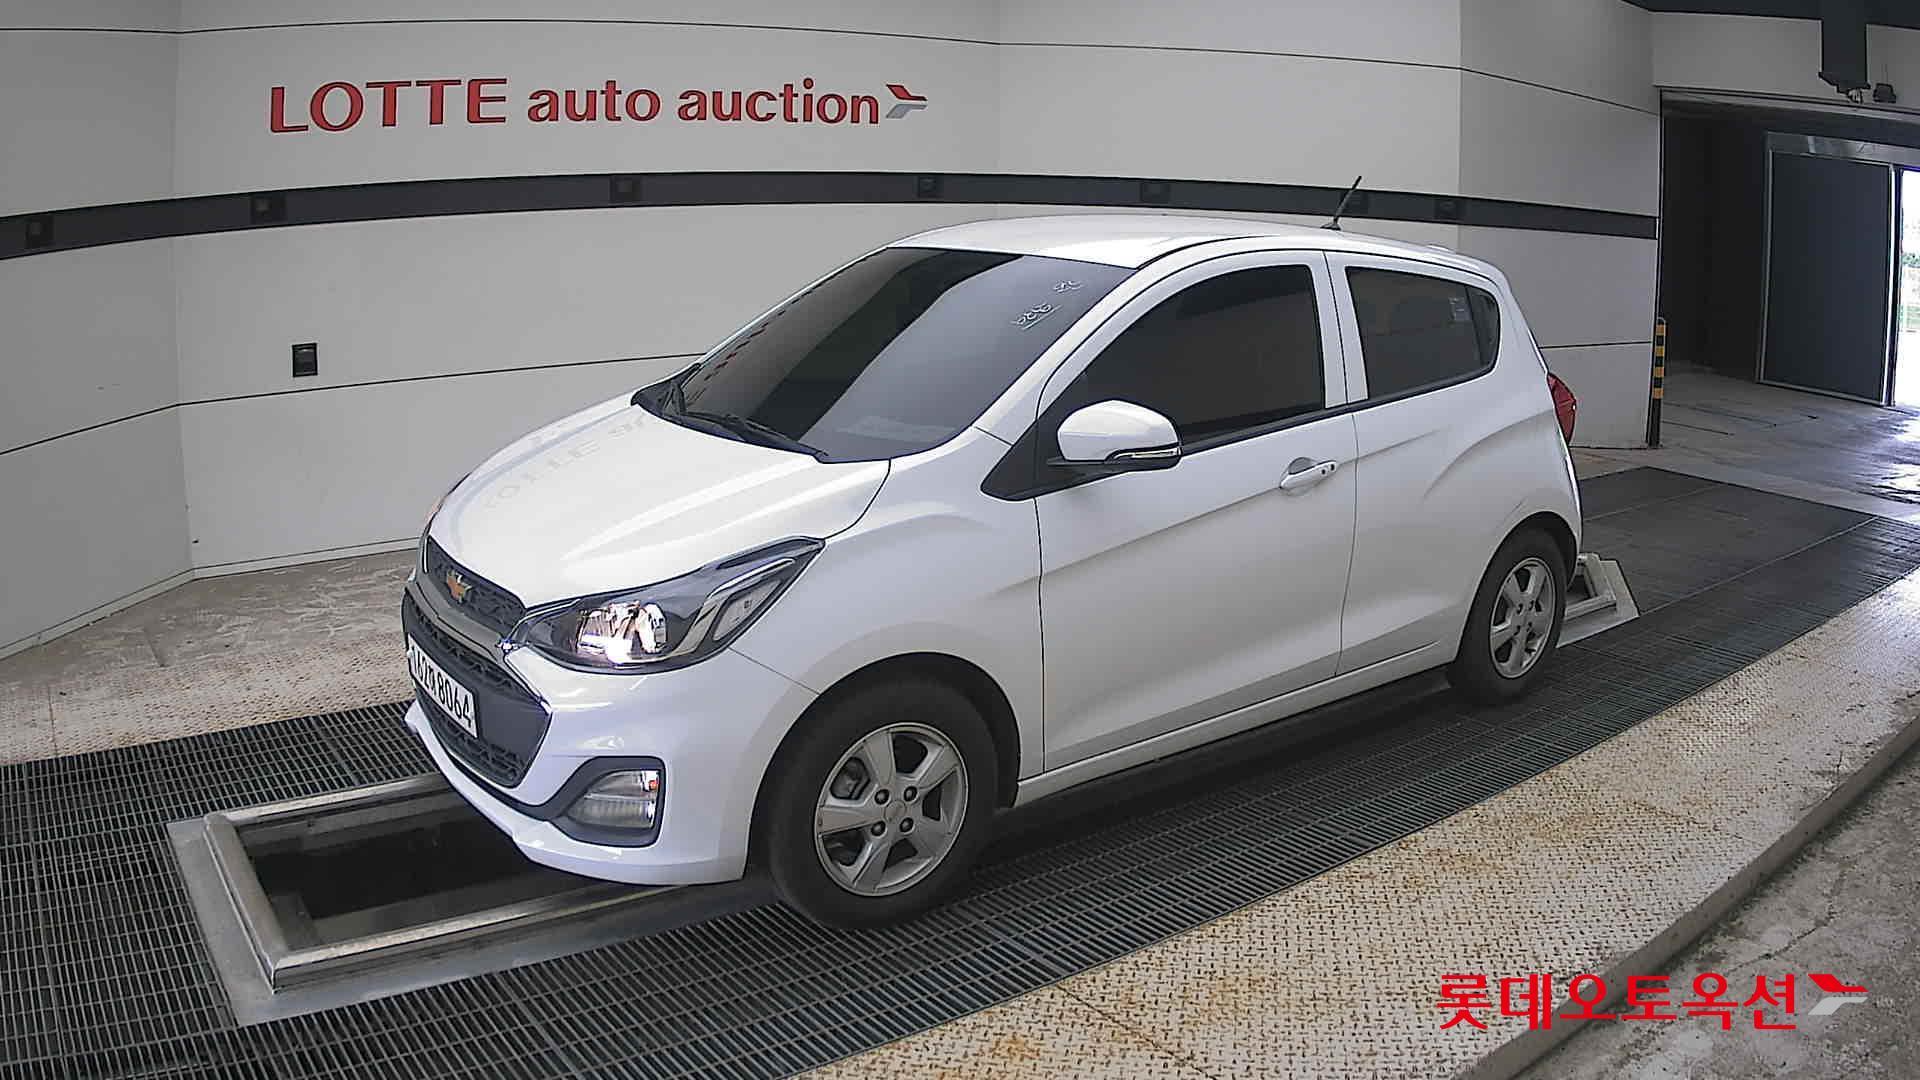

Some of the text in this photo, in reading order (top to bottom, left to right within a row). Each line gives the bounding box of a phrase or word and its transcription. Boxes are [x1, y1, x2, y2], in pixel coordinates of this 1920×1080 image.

[269, 77, 881, 133] LOTTE auto auction
[437, 671, 474, 729] 8064
